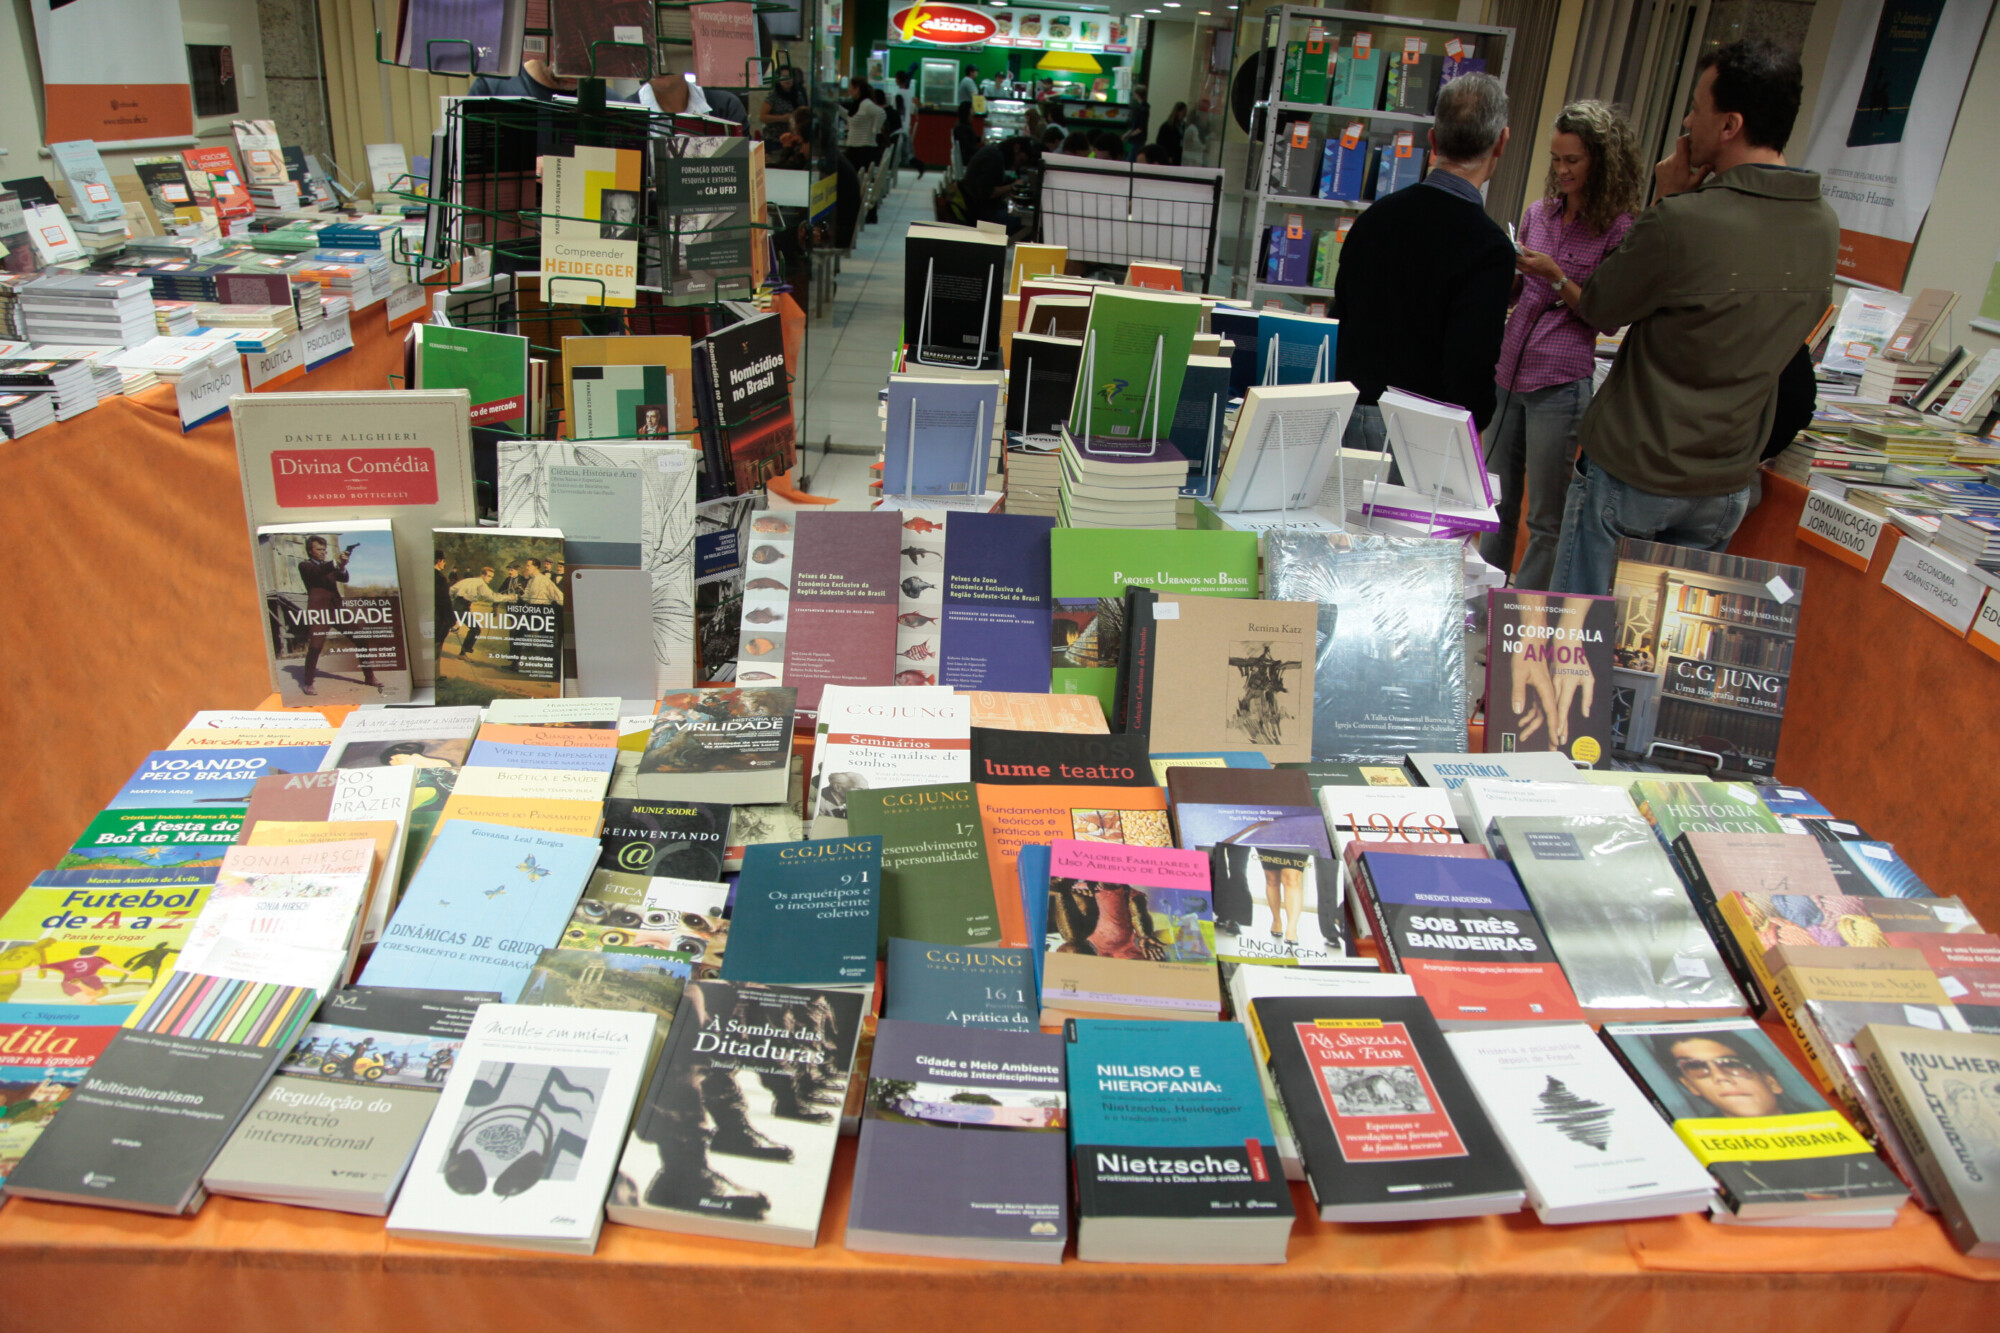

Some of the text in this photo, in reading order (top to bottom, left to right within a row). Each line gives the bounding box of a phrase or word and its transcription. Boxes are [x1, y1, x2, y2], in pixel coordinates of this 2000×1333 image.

[681, 165, 737, 175] FORMAÇÃO DOCENTE,
[712, 175, 737, 184] EXTENSÃO
[719, 186, 737, 195] UFRJ
[555, 244, 624, 260] Compreender
[545, 258, 634, 278] HEIDEGGER
[306, 327, 347, 353] PSICOLOGIA
[261, 349, 293, 374] POLÍTICA
[730, 354, 784, 385] Homicídios
[190, 373, 232, 402] NUTRIÇÃO
[746, 371, 774, 395] Brasil
[488, 401, 517, 414] mercado
[284, 432, 419, 443] DANTE ALIGHIERI
[279, 455, 430, 475] Divina Comédia
[582, 469, 637, 479] História Arte
[306, 490, 409, 500] SANDRO BOTTICELLI
[1808, 496, 1878, 538] COMUNICAÇÃO
[1807, 518, 1866, 552] JORNALISMO
[1113, 570, 1249, 585] PARQUES URBANOS BRASIL
[1917, 559, 1955, 588] ECONOMIA
[950, 583, 983, 591] Econômica
[342, 598, 377, 607] HISTÓRIA
[507, 604, 541, 614] HISTÓRIA
[1504, 604, 1576, 615] MONIKA MATSCHNIG
[288, 607, 393, 626] VIRILIDADE
[454, 611, 555, 632] VIRILIDADE
[1721, 605, 1793, 624] SONU SHAMDASANI
[1248, 622, 1303, 635] Renina Katz
[1503, 624, 1603, 643] O CORPO FALA
[1503, 640, 1587, 665] NO AMOR
[1677, 661, 1781, 694] C.G. JUNG
[1675, 682, 1777, 709] Uma Biografia Livros
[674, 721, 784, 731] VIRILIDADE
[850, 734, 931, 750] Seminários
[848, 749, 939, 761] sobre análise
[150, 757, 267, 771] VOANDO
[848, 759, 897, 769] sonhos
[984, 759, 1135, 779] lume teatro
[1432, 763, 1509, 777] RESISTÊNCIA
[140, 770, 258, 781] PELO BRASIL
[498, 771, 599, 784] BIOÉTICA SAÚDE
[332, 796, 401, 814] PRAZER
[632, 805, 698, 816] MUNIZ SODRÉ
[986, 804, 1066, 815] Fundamentos
[1667, 801, 1761, 819] HISTÓRIA
[530, 810, 592, 822] PENSAMENTO
[998, 814, 1046, 826] teóricos
[150, 820, 206, 832] festa
[955, 823, 974, 837] 17
[992, 826, 1041, 838] práticos
[95, 832, 135, 845] Boi
[472, 828, 510, 840] Giovanna
[602, 827, 720, 842] REINVENTANDO
[894, 850, 980, 870] personalidade
[1073, 851, 1123, 863] VALORES
[1251, 853, 1289, 866] CORNELIA
[604, 882, 643, 897] ÉTICA
[791, 887, 860, 902] arquétipos
[61, 889, 201, 909] Futebol
[787, 898, 871, 910] inconsciente
[41, 911, 191, 929] de A Z
[816, 907, 870, 919] coletivo
[1409, 916, 1520, 934] SOB TRÊS
[390, 923, 546, 957] DINÂMICAS GRUPO
[1406, 933, 1537, 952] BANDEIRAS
[382, 941, 458, 959] CRESCIMENTO
[962, 1009, 1013, 1026] prática
[1772, 984, 1818, 1061] FILOSOFIA
[725, 1019, 823, 1042] Sombra das
[692, 1032, 825, 1064] Ditaduras
[1338, 1033, 1408, 1048] SENZALA,
[1320, 1049, 1357, 1060] UMA
[916, 1055, 1059, 1075] Cidade Meio Ambiente
[1097, 1064, 1185, 1079] NIILISMO
[928, 1068, 1059, 1084] Estudos Interdisciplinares
[85, 1078, 204, 1105] Multiculturalismo
[1099, 1079, 1222, 1094] HIEROFANIA:
[268, 1086, 392, 1113] Regulação do
[1102, 1103, 1243, 1116] Nietzsche, Heidegger
[256, 1108, 340, 1129] comércio
[243, 1125, 375, 1151] internacional
[1701, 1131, 1851, 1152] LEGIÃO URBANA
[1097, 1152, 1249, 1175] Nietzsche,
[1097, 1174, 1252, 1183] cristianismo Deus não-cristão
